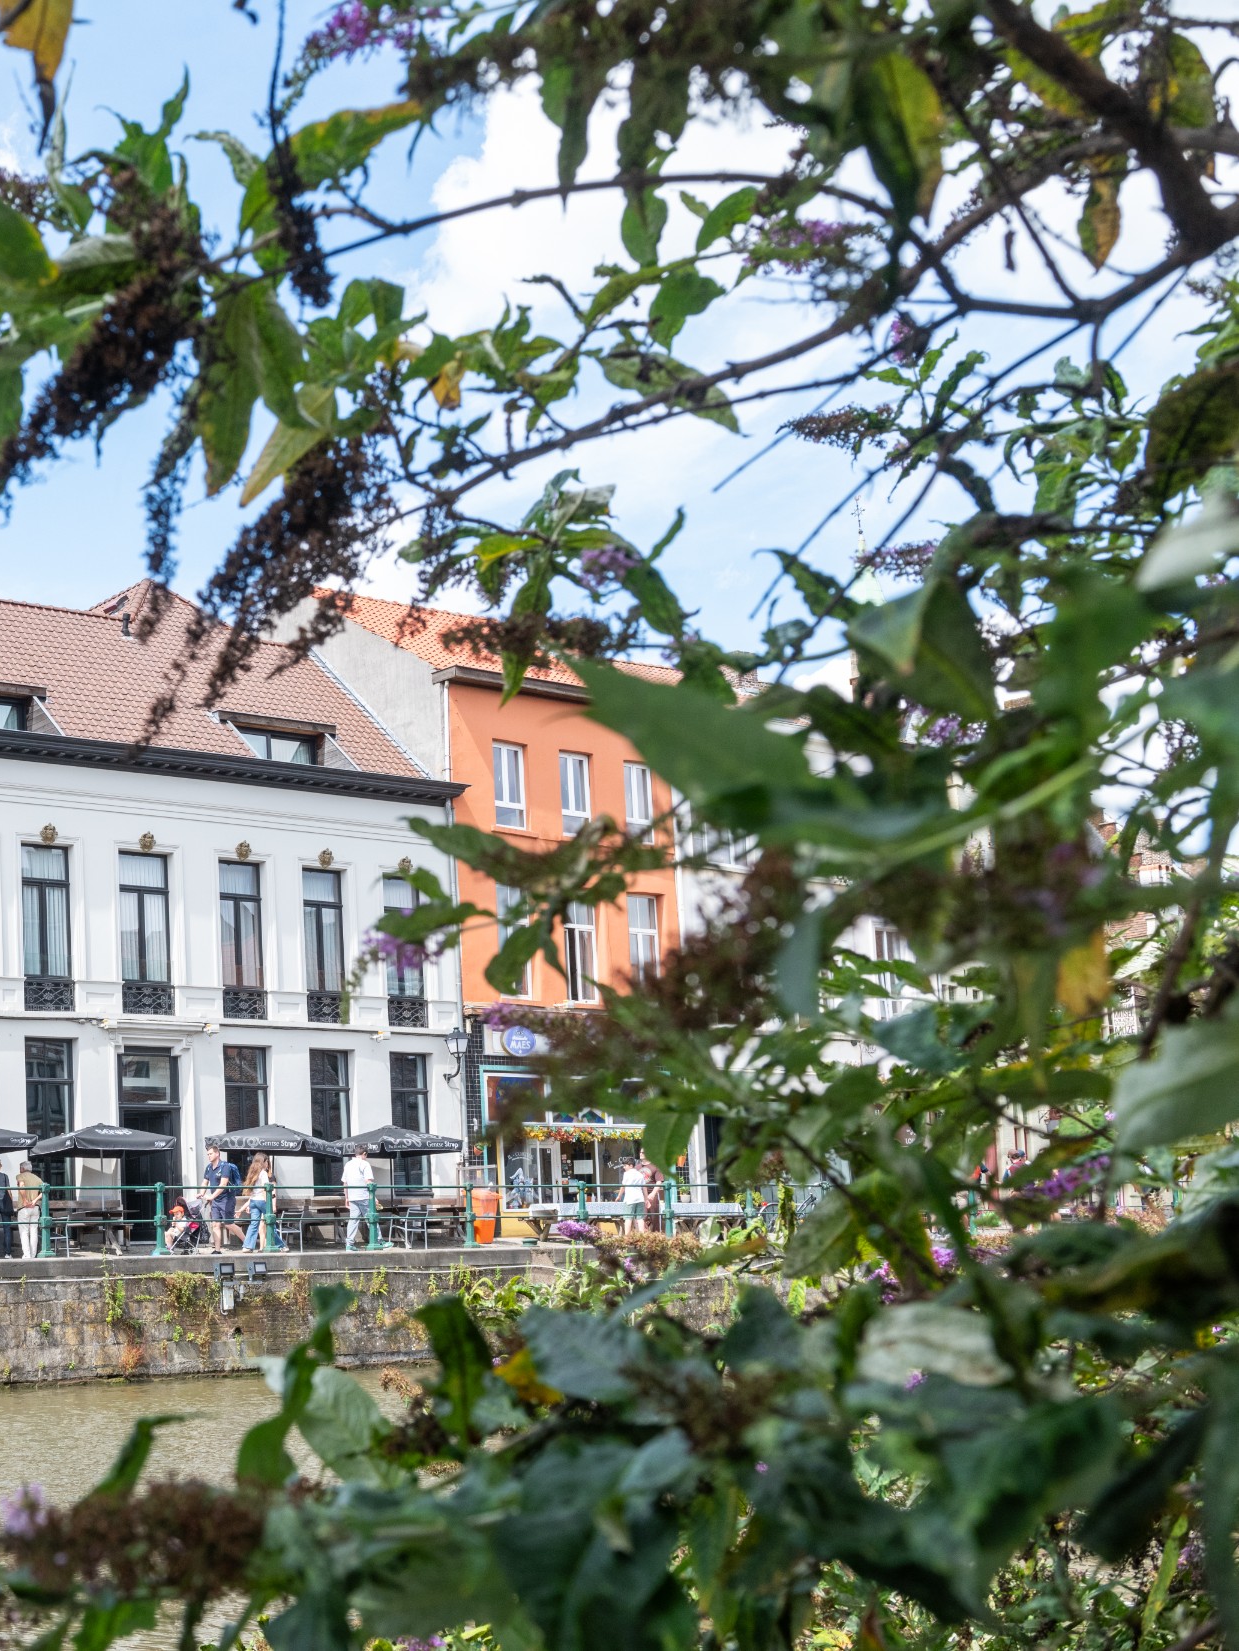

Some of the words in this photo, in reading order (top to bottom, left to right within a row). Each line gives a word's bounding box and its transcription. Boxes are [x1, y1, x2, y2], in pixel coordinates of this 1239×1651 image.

[510, 1040, 531, 1050] MAES
[259, 1139, 280, 1147] Gentse
[280, 1139, 298, 1148] Strop
[444, 1141, 459, 1149] Strop
